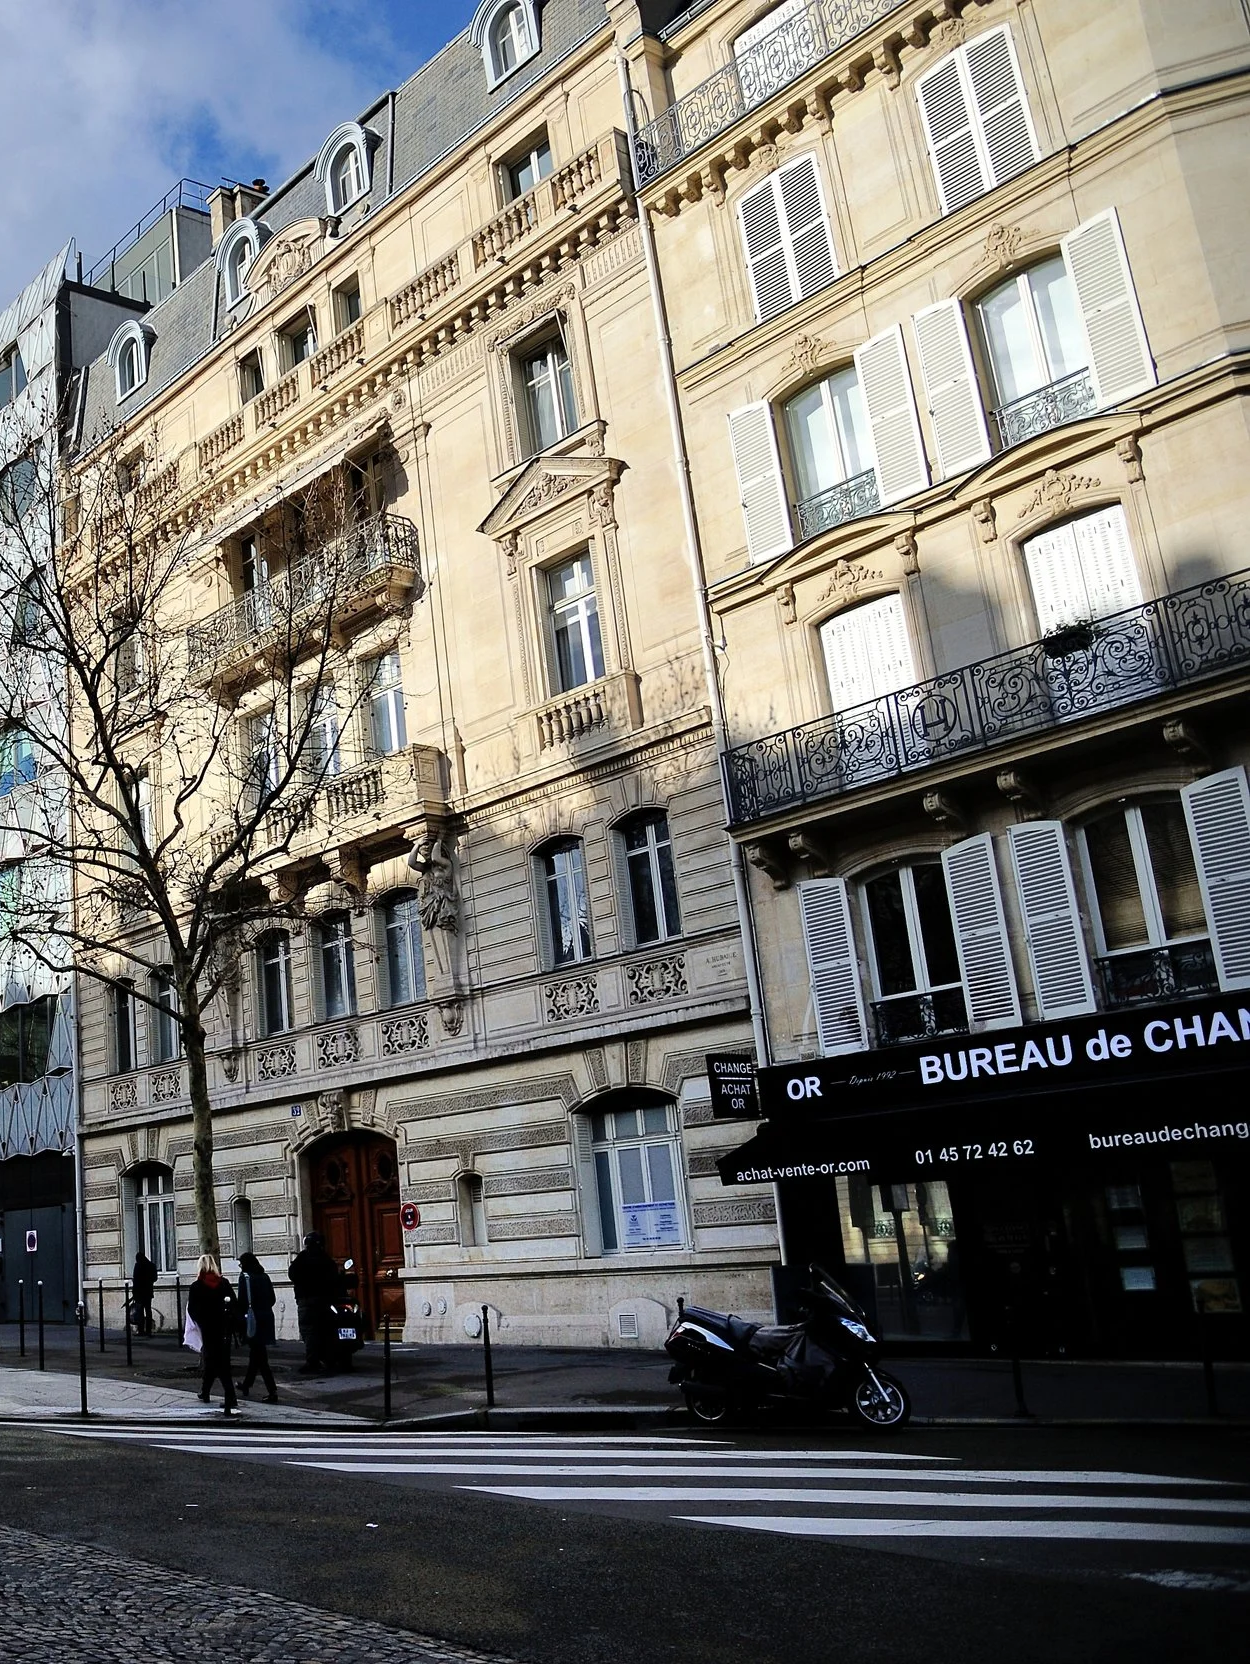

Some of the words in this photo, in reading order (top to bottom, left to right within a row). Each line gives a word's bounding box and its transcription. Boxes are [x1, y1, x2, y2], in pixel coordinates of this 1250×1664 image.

[713, 1062, 752, 1075] CHANGE
[786, 1076, 823, 1100] OR
[848, 1074, 874, 1086] Depuis
[876, 1070, 897, 1082] 1992
[919, 1034, 1074, 1085] BUREAU
[1085, 1029, 1133, 1061] de
[720, 1083, 751, 1096] ACHAT
[731, 1098, 746, 1109] OR
[1089, 1120, 1249, 1149] bureaudechang
[914, 1149, 933, 1165] 01
[939, 1146, 959, 1162] 45
[963, 1143, 983, 1160] 72
[988, 1141, 1008, 1157] 42
[1013, 1138, 1035, 1155] 62
[736, 1158, 871, 1182] achat-vente-or.com
